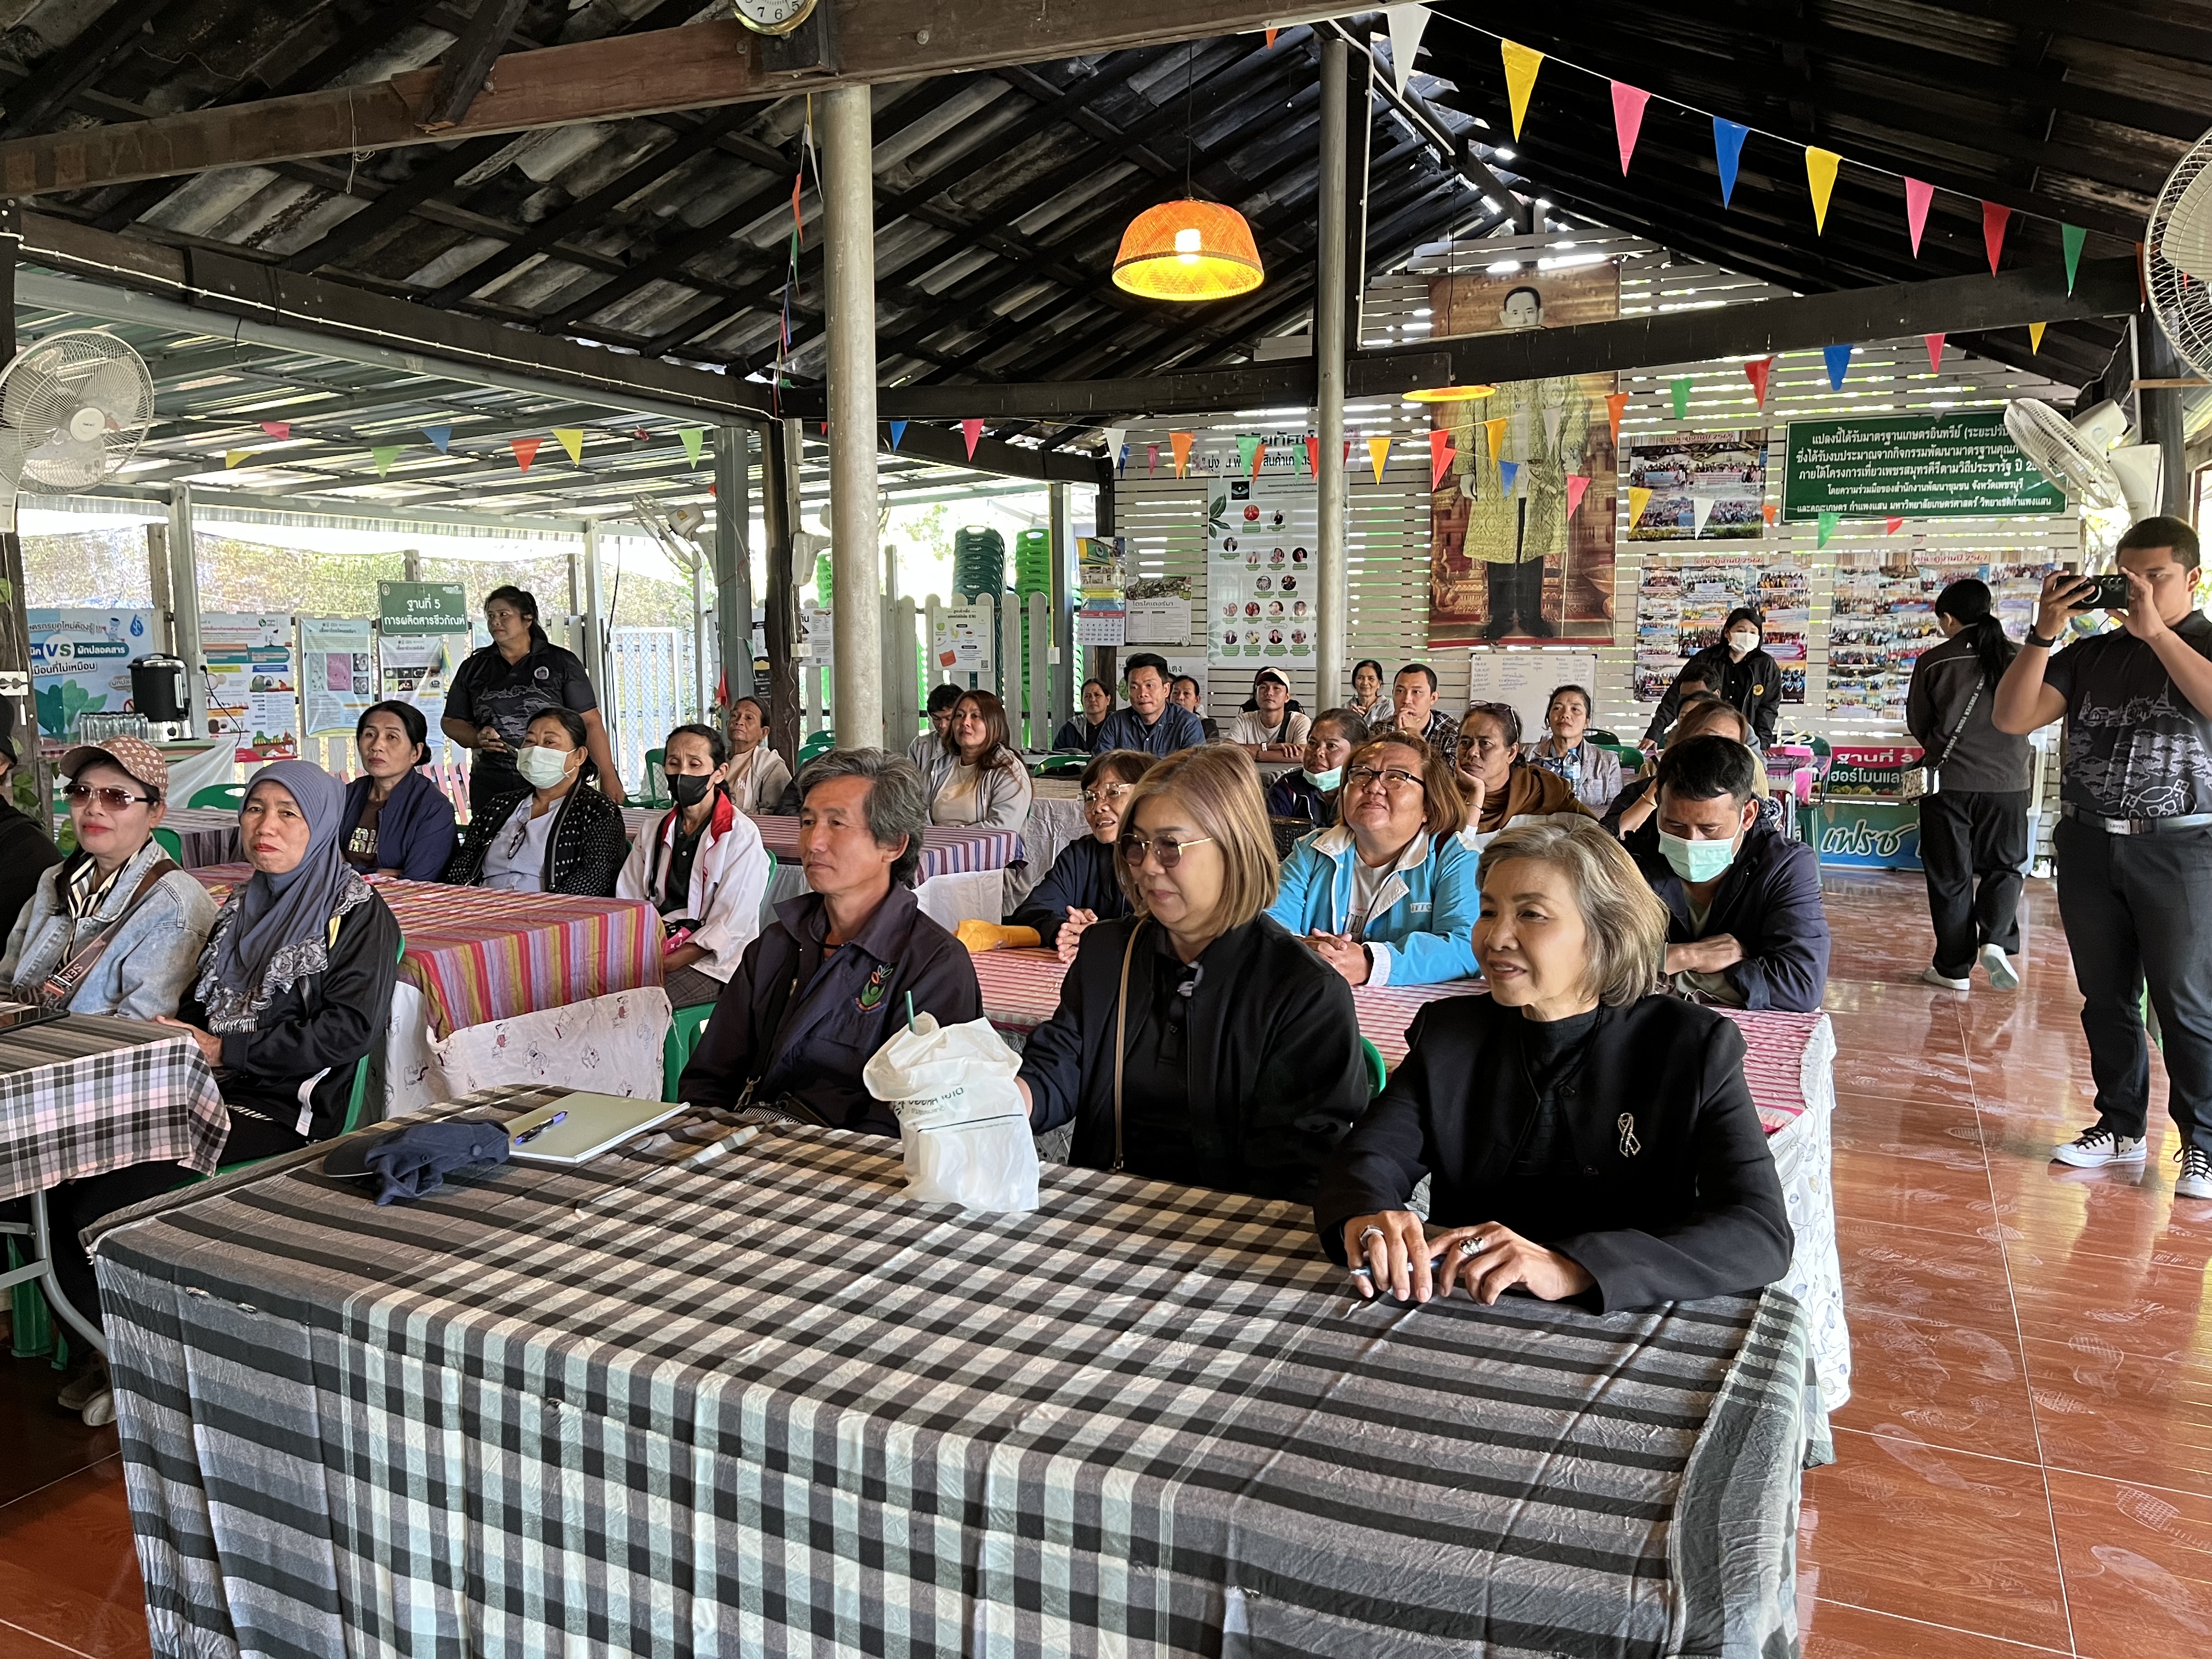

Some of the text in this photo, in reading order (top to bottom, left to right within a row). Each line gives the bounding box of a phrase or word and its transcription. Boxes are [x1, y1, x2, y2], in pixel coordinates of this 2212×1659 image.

[758, 7, 765, 17] 7
[792, 1, 799, 12] 5
[775, 9, 782, 20] 6
[2015, 458, 2023, 472] ปี
[1972, 477, 2024, 493] จังหวัดเพชรบุรี
[1849, 500, 1887, 511] กำแพงแสน
[407, 593, 441, 612] ฐานที่ 5
[46, 644, 71, 657] VS
[33, 661, 95, 675] มือนที่ไม่เหมือน
[1836, 748, 1914, 764] ฐานที่ 3
